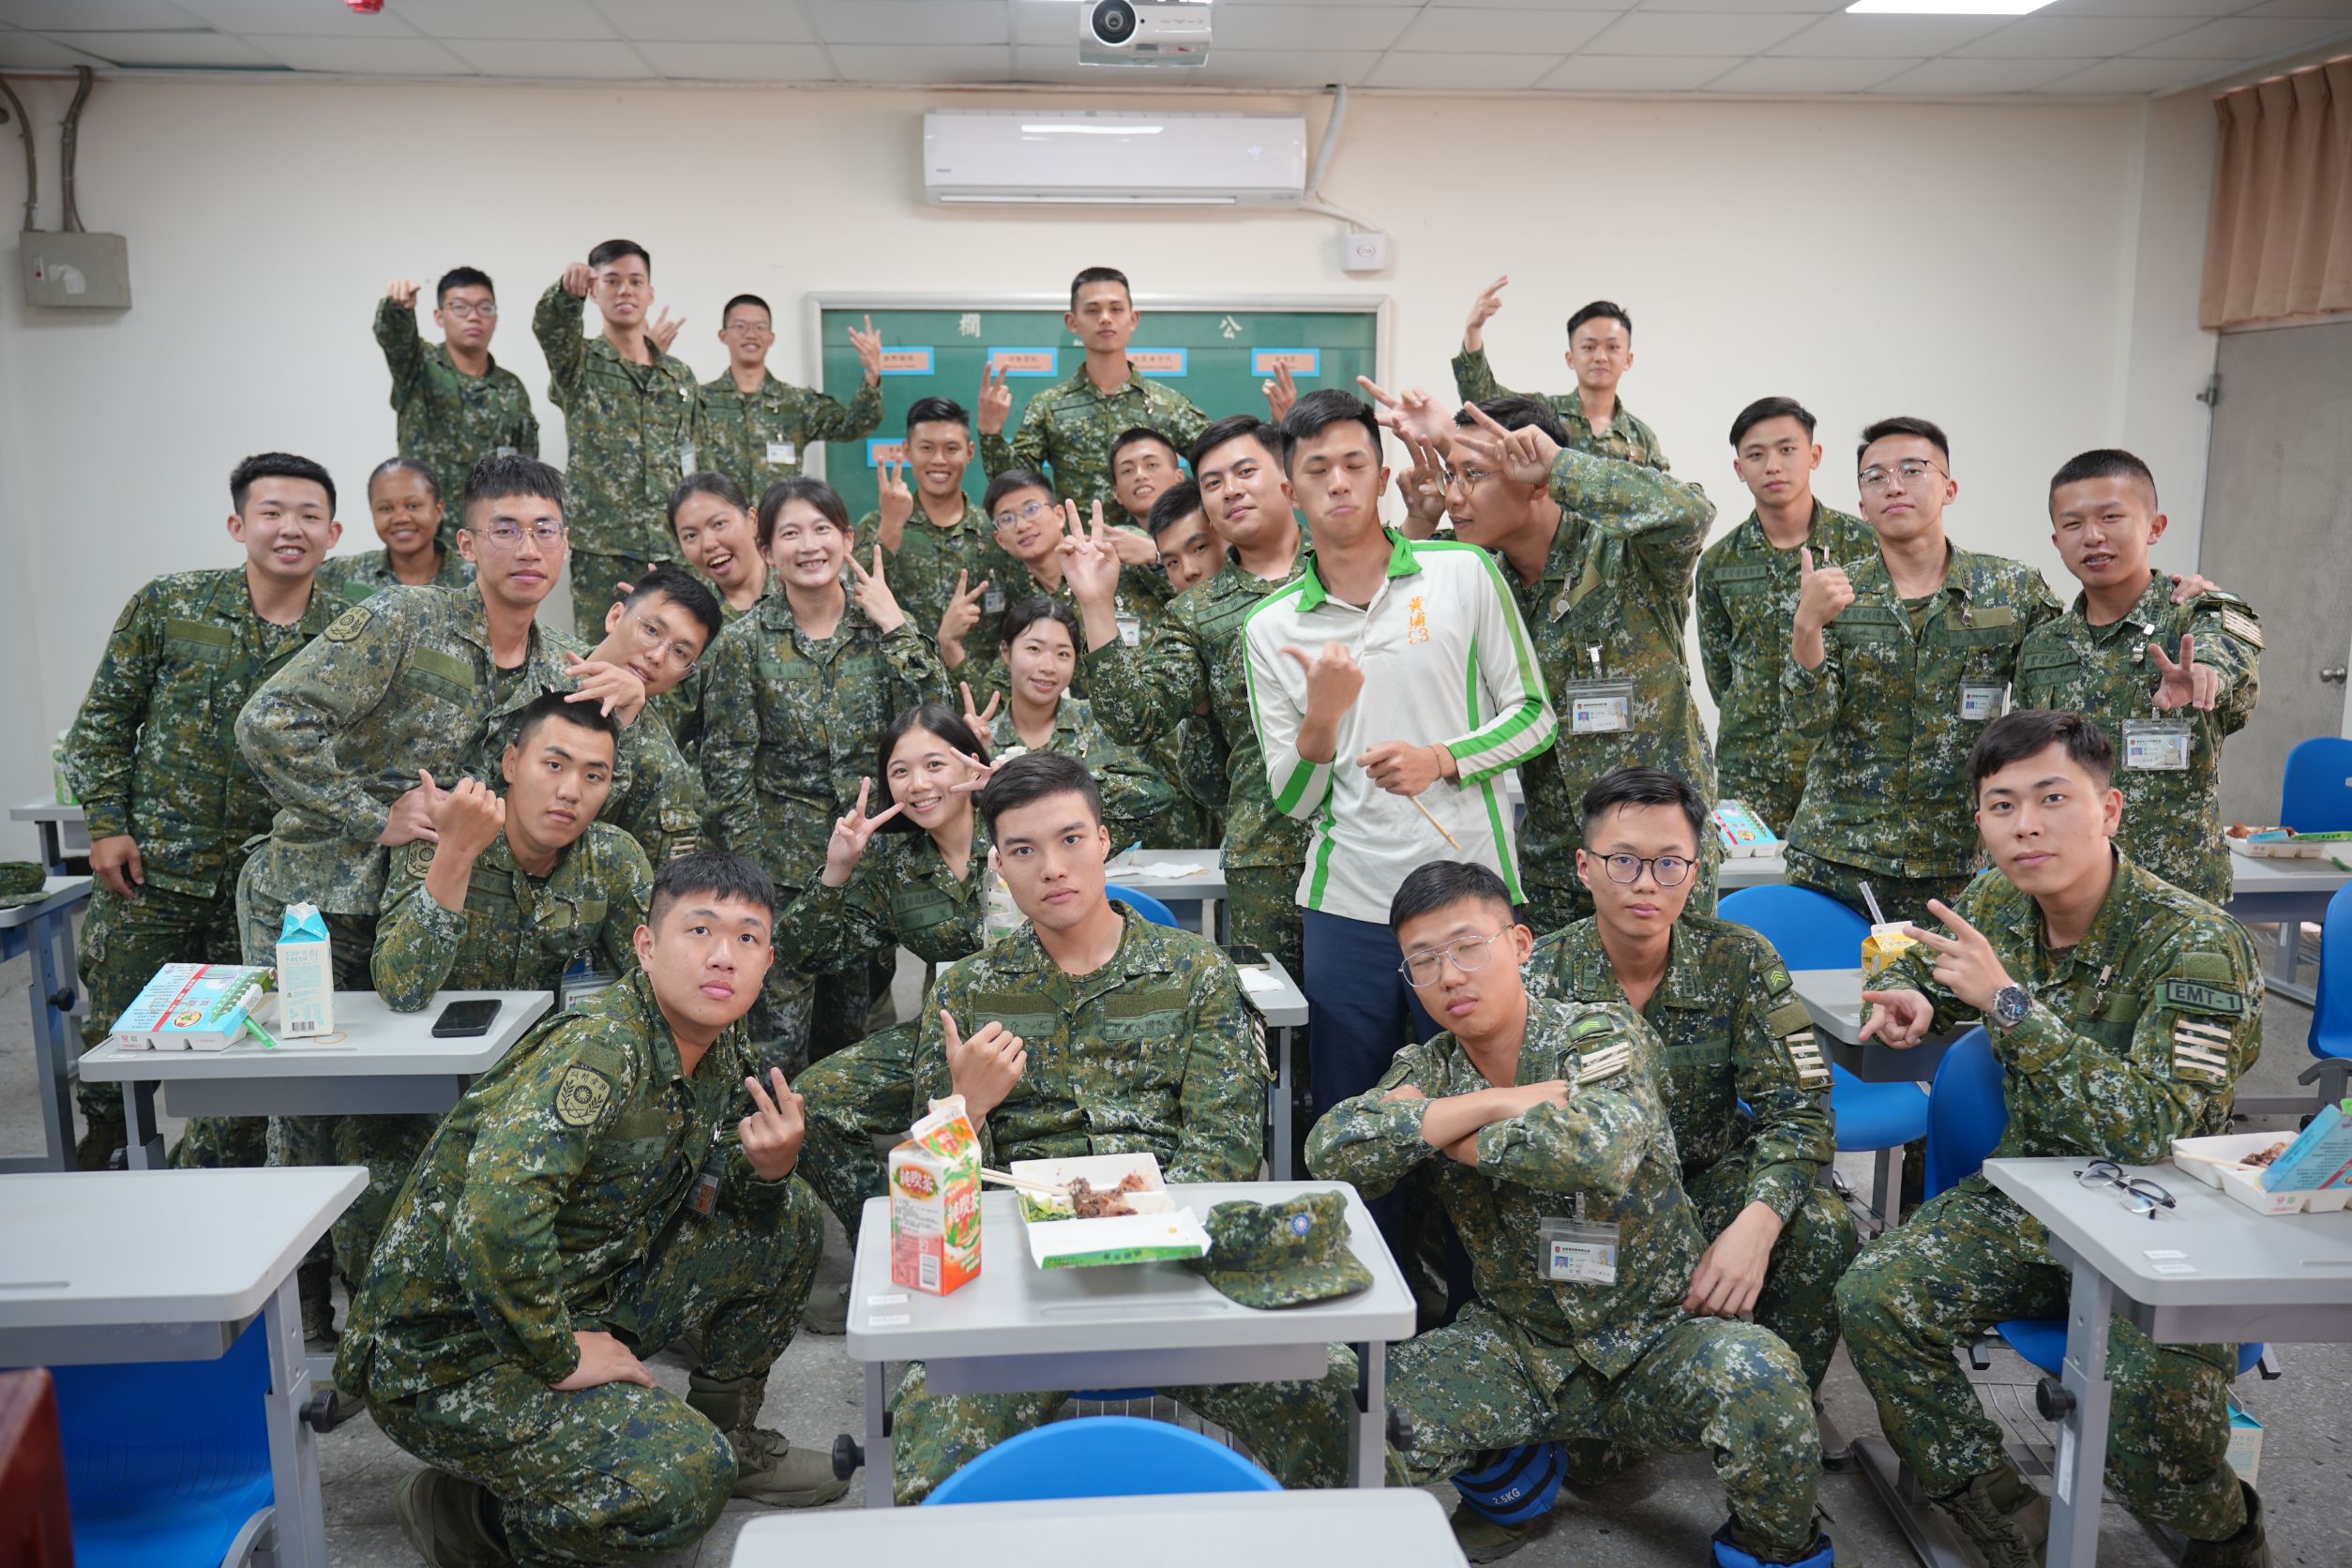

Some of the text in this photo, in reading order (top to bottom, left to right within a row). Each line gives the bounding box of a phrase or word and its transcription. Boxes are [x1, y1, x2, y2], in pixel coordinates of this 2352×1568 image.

[958, 313, 981, 339] 欄
[1219, 315, 1243, 339] 公
[2175, 984, 2235, 1009] EMT-1
[1492, 1487, 1521, 1505] 2.5KG
